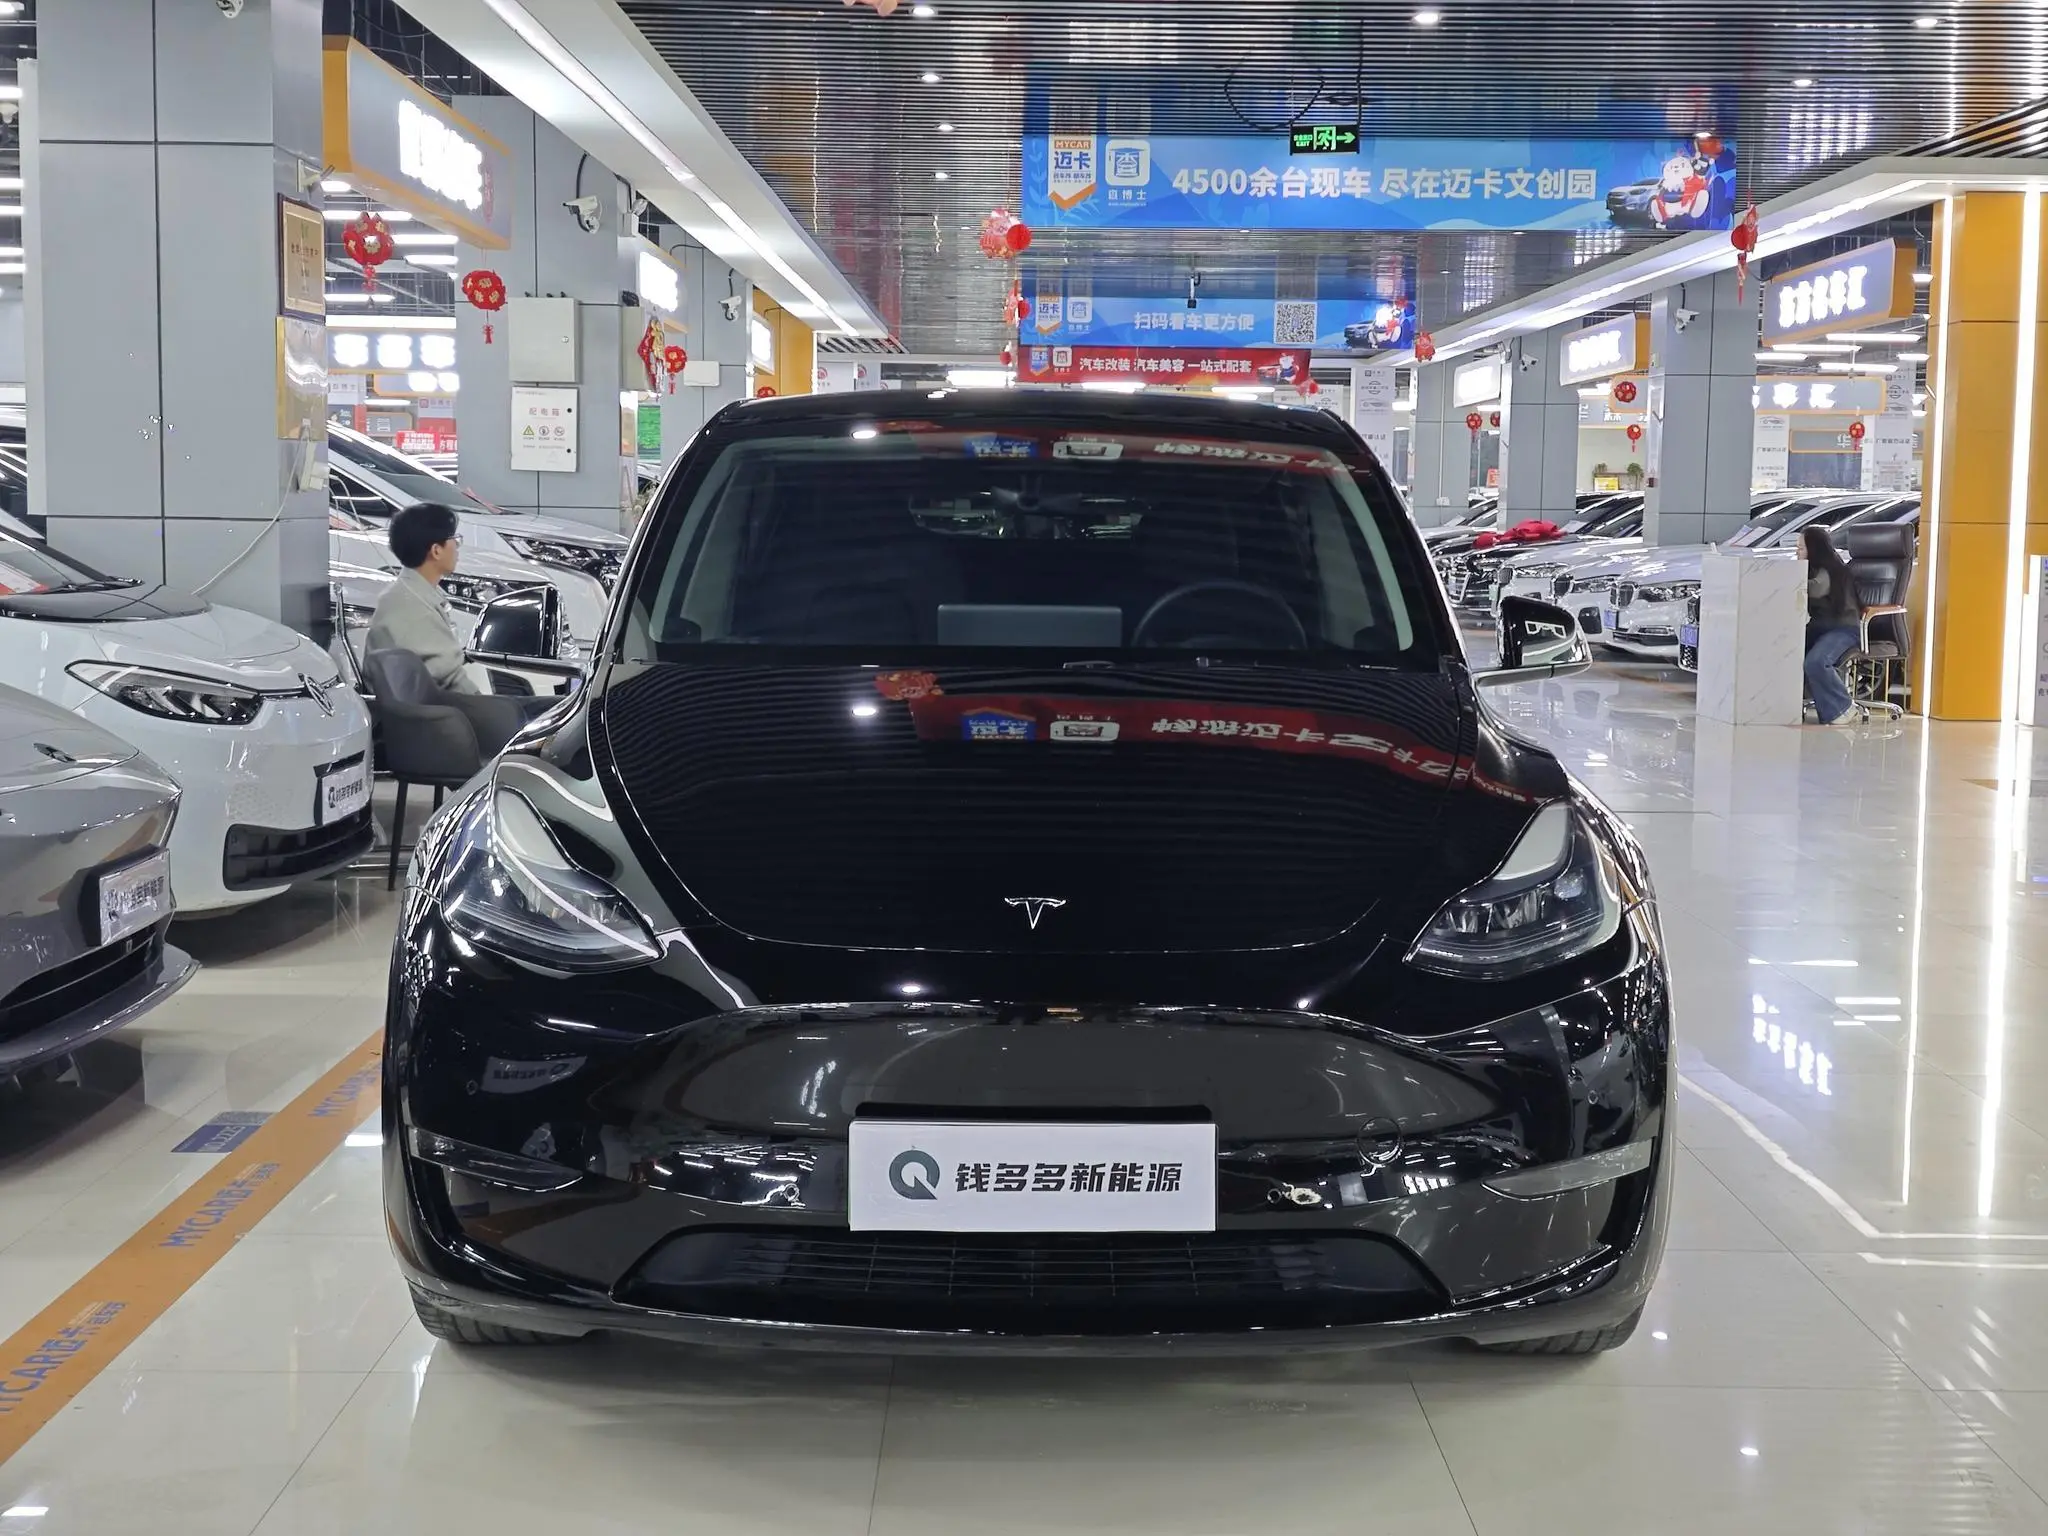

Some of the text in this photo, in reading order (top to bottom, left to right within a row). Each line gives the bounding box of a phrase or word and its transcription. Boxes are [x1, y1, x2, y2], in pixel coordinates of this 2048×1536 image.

[1055, 141, 1090, 149] MYCAR
[1054, 151, 1091, 170] 迈卡
[1172, 166, 1597, 200] 4500余台现车 尽在迈卡文创园
[1038, 303, 1060, 314] 迈卡
[1134, 312, 1254, 331] 扫码看车更方便
[1079, 357, 1130, 372] 汽车改装
[1134, 358, 1185, 373] 汽车美容
[1187, 359, 1252, 373] 一站式配套
[529, 407, 560, 417] 配电箱
[955, 1162, 1183, 1193] 钱多多新能源
[160, 1199, 241, 1247] MYCAR
[0, 1351, 74, 1413] CAR
